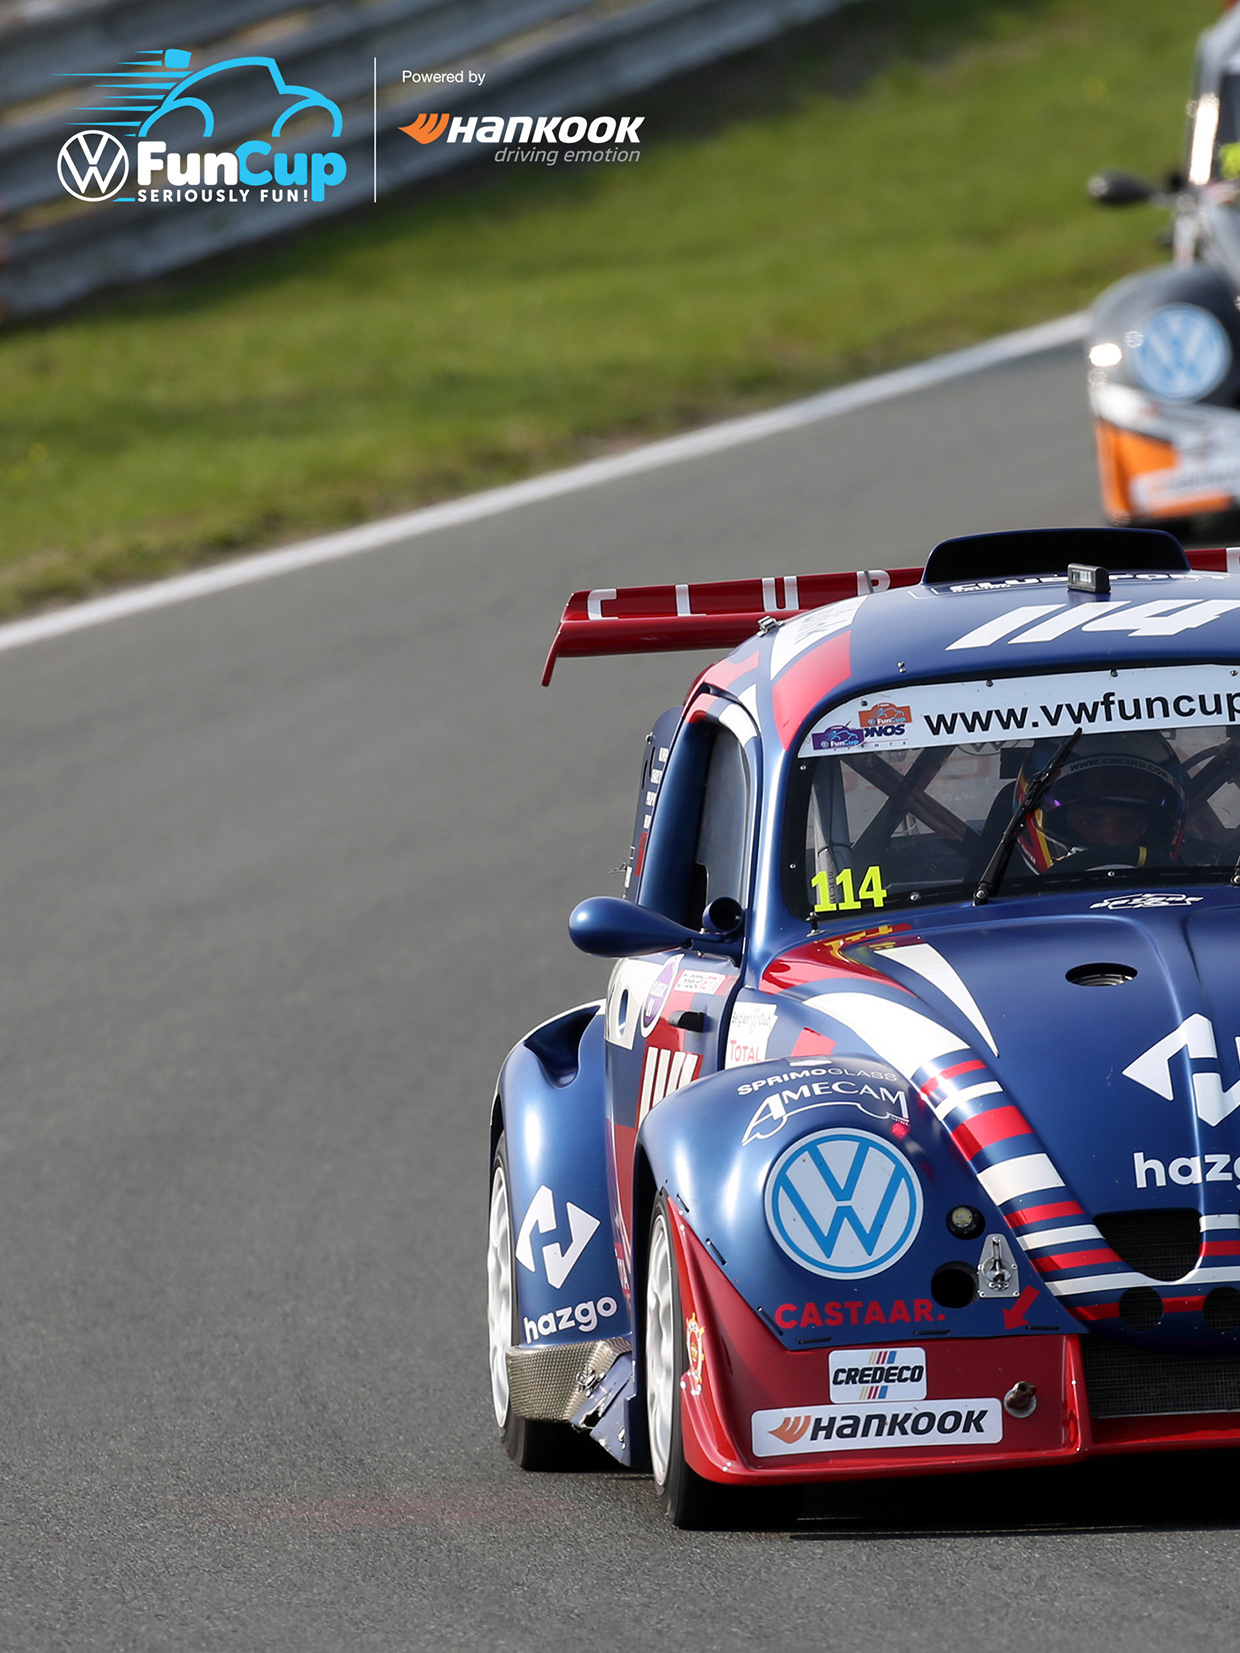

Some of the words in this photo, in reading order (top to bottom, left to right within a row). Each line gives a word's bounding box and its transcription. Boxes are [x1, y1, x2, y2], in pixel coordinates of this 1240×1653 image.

[811, 866, 888, 912] 114
[737, 1067, 898, 1096] SPRIMOGLASS
[741, 1080, 910, 1147] AMECAM
[771, 1133, 917, 1274] VW
[523, 1296, 618, 1344] hazgo
[774, 1298, 946, 1329] CASTAAR.
[832, 1365, 924, 1386] CREDECO
